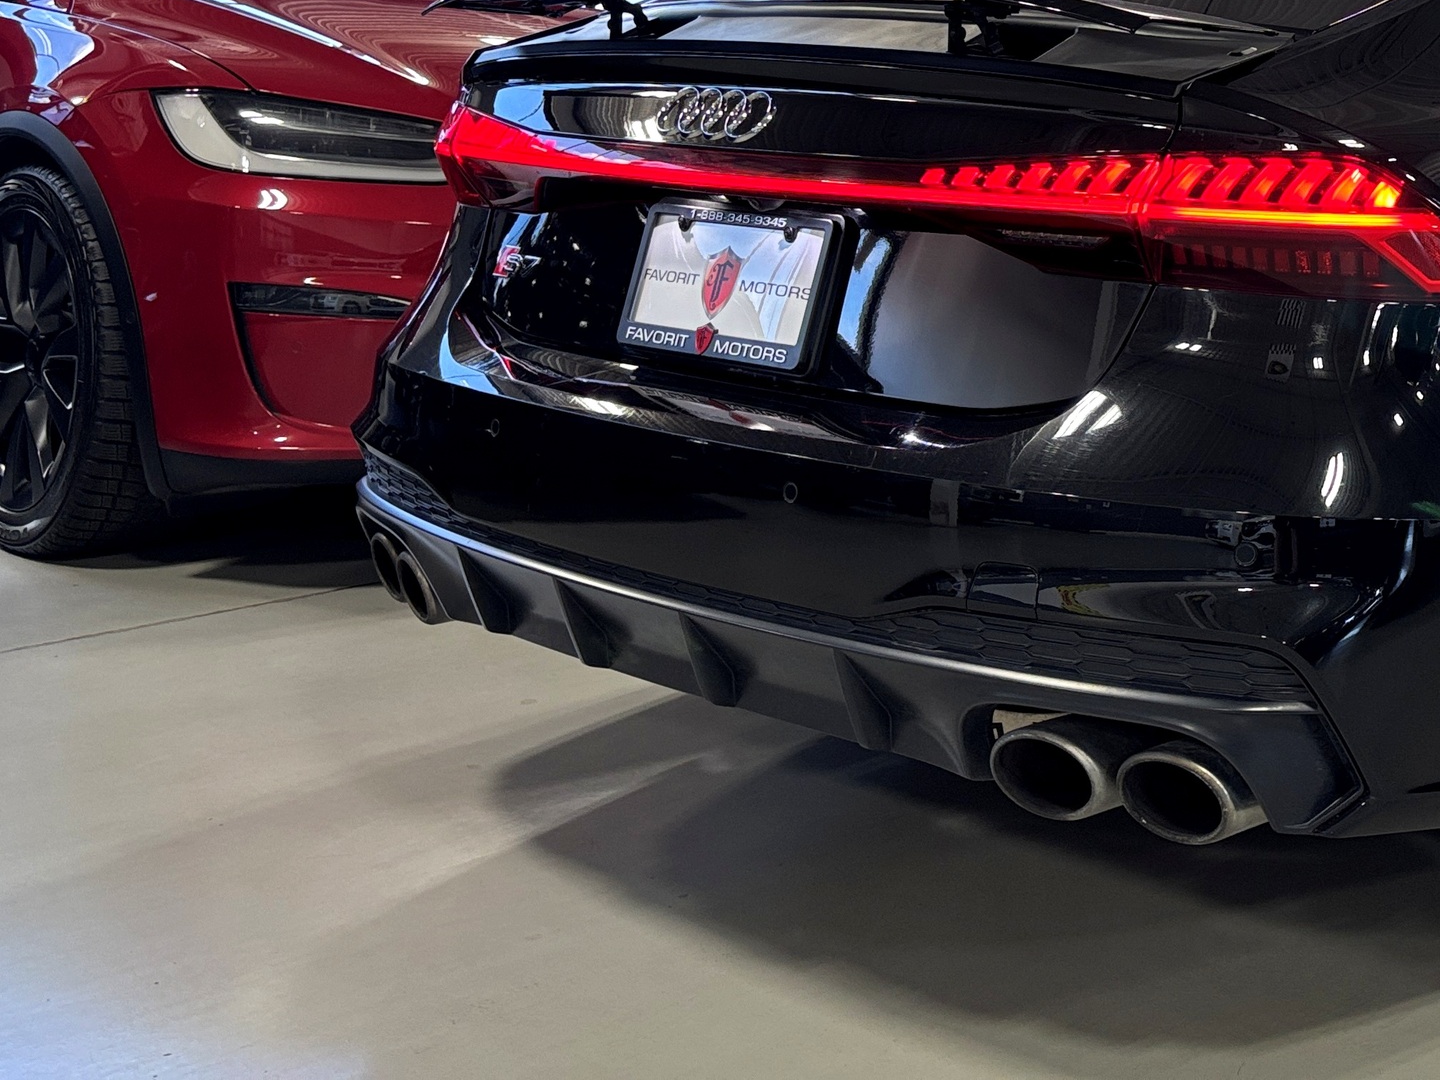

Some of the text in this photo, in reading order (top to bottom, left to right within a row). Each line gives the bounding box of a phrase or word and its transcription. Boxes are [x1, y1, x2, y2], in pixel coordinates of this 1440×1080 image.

[690, 209, 787, 228] 1-888-345-9345
[644, 268, 700, 286] FAVORIT
[738, 280, 811, 300] MOTORS
[625, 327, 689, 348] FAVORIT
[712, 340, 787, 363] MOTORS
